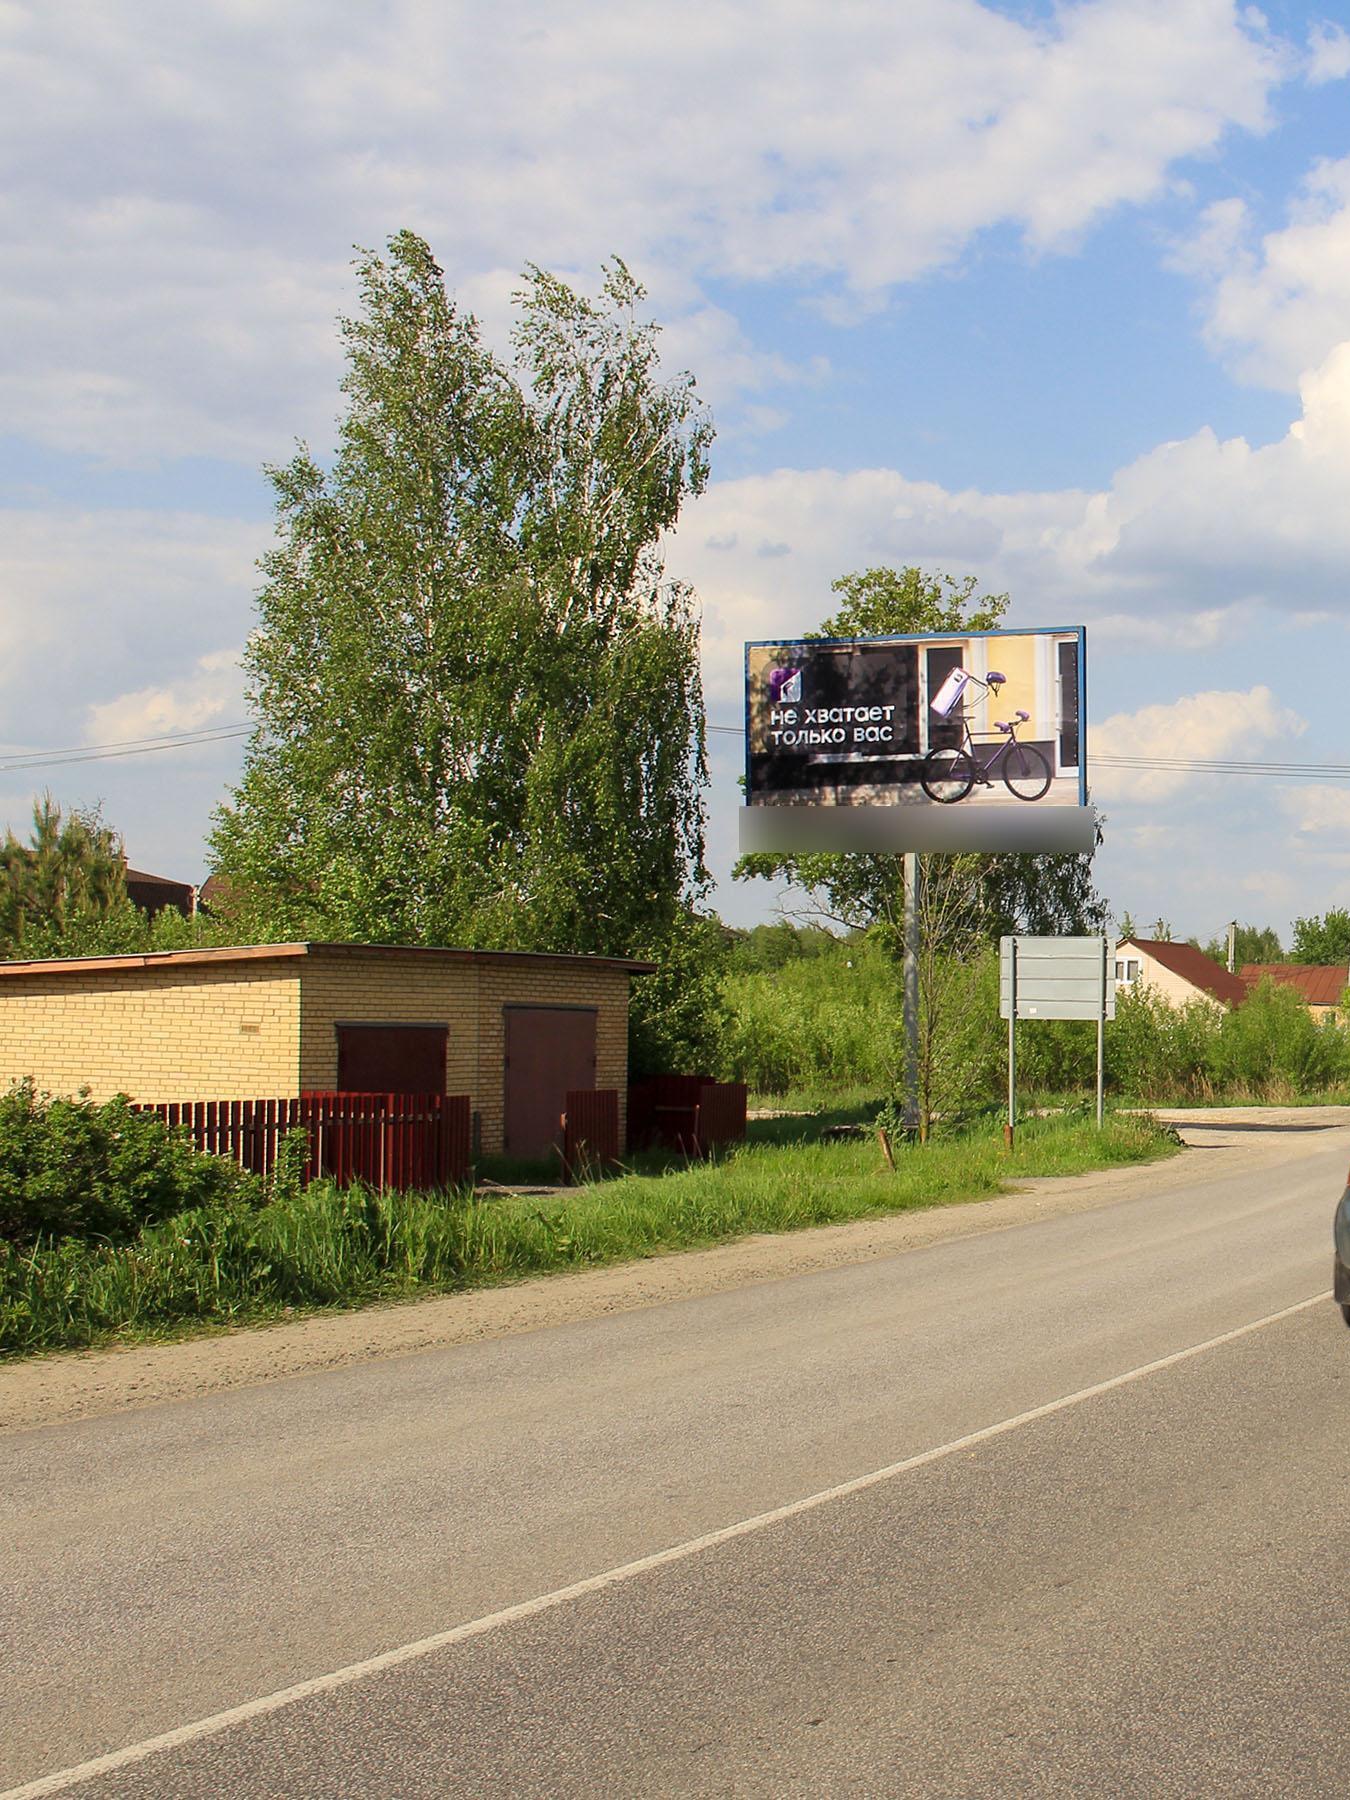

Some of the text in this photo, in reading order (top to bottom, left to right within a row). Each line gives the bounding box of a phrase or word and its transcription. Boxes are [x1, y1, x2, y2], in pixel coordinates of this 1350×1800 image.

[770, 705, 895, 725] не хватает
[770, 725, 893, 745] только вас
